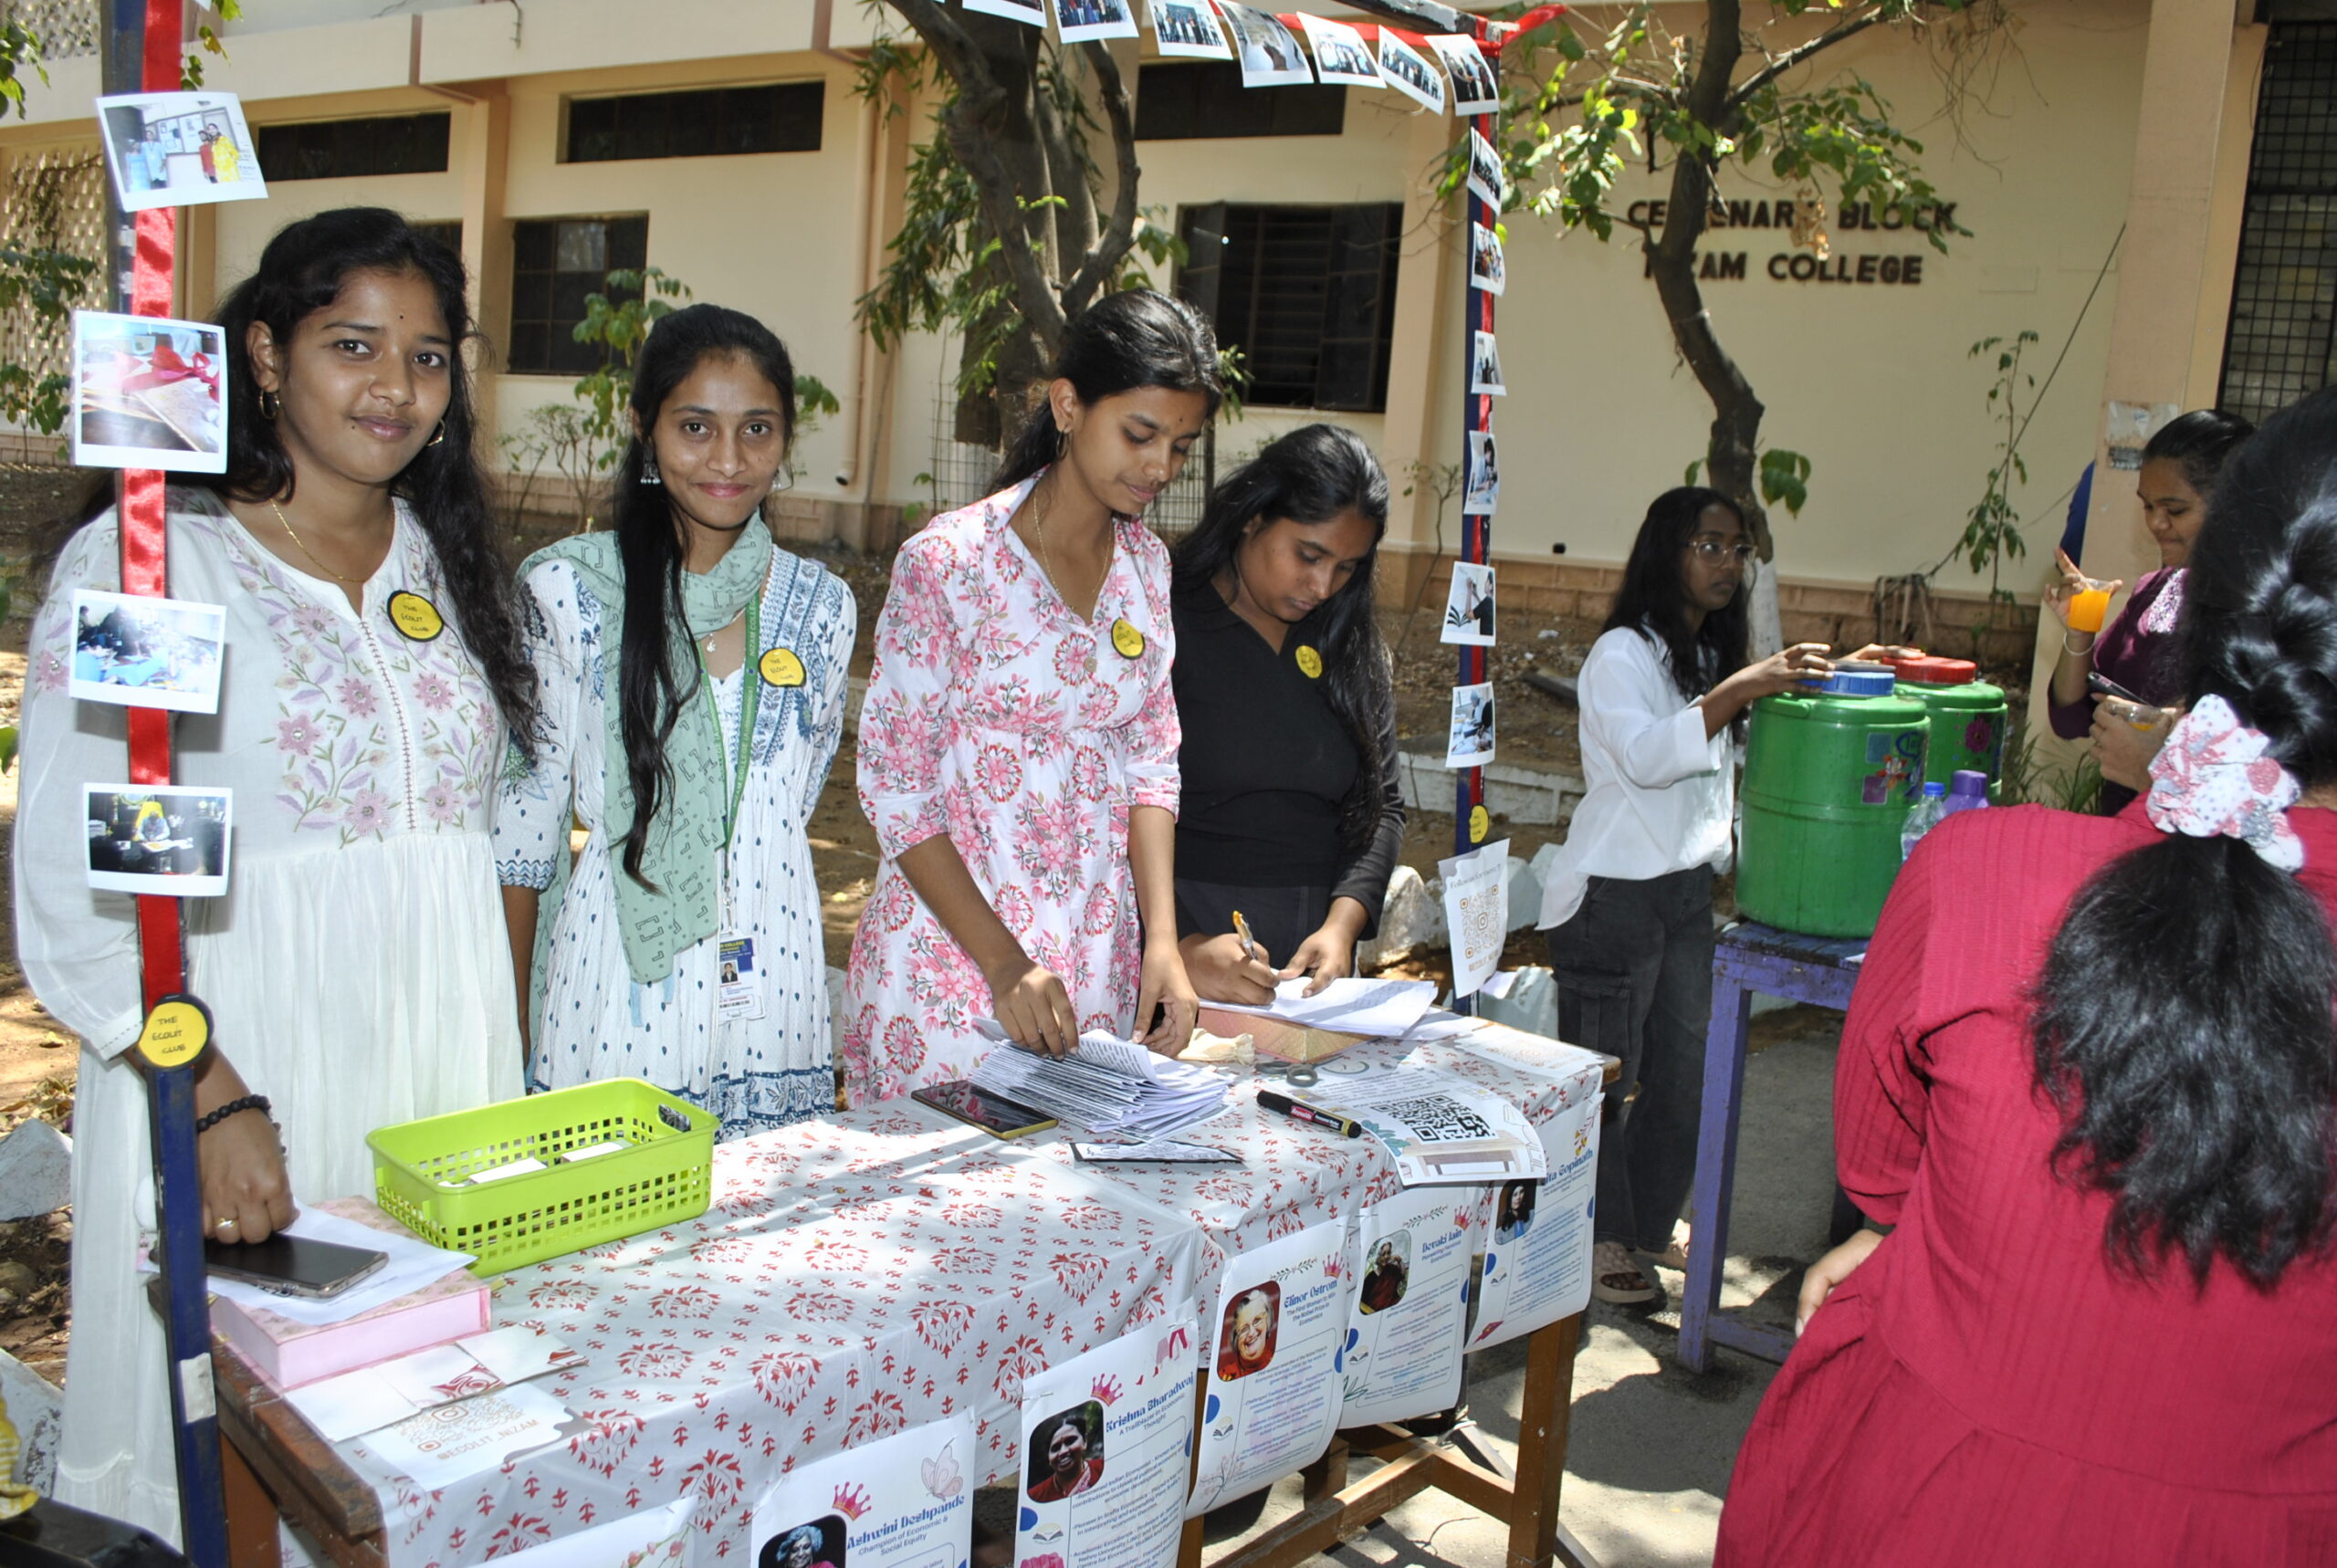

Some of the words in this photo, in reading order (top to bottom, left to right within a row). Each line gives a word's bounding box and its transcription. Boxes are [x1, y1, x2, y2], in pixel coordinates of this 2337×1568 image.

[1628, 199, 1816, 227] CEENAR
[1767, 252, 1923, 285] COLLEGE
[737, 743, 748, 781] COLLEGE
[157, 1015, 178, 1025] THE
[1284, 1292, 1309, 1308] Elinor
[1310, 1280, 1337, 1297] Ostrom
[1106, 1406, 1146, 1432] Krishna
[1148, 1372, 1194, 1411] Bharadwaj
[847, 1519, 897, 1550] Ashwini
[901, 1495, 965, 1529] Deshpande
[858, 1535, 897, 1555] Champion
[898, 1531, 906, 1540] of
[907, 1519, 942, 1537] Economic
[881, 1540, 903, 1556] Social
[904, 1533, 927, 1547] Equity
